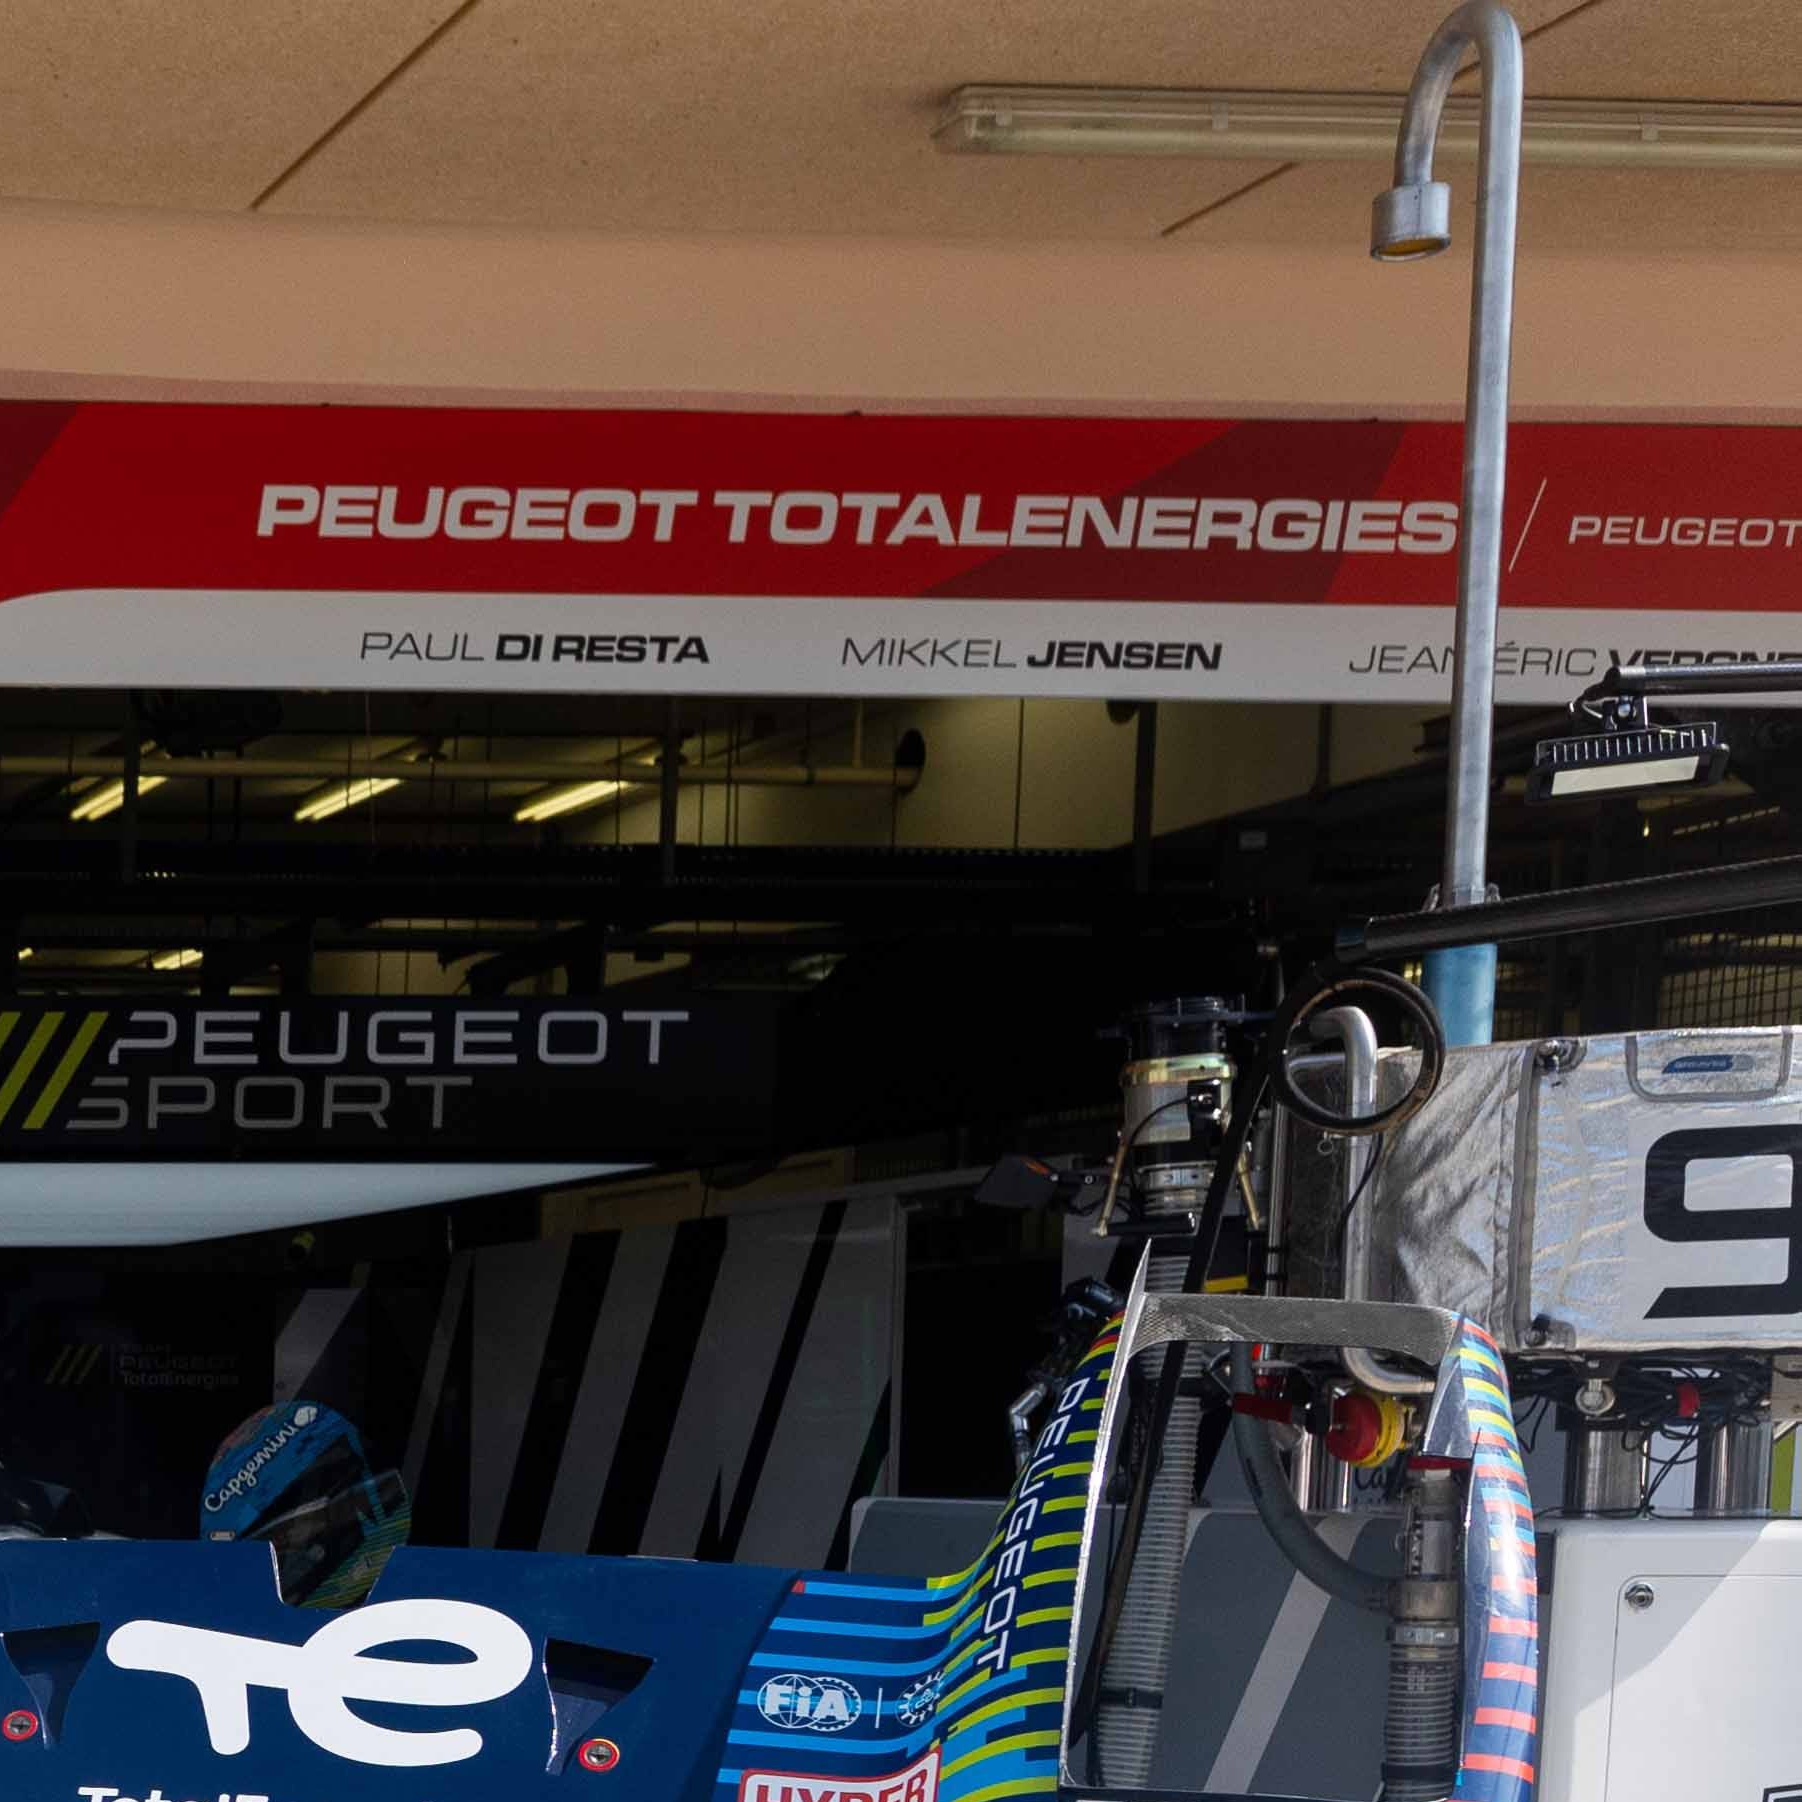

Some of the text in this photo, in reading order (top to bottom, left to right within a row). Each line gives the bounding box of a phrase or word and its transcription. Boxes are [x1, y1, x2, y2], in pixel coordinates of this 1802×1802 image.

[257, 484, 1459, 555] PEUGEOT TOTALENERGIES
[1568, 515, 1802, 549] PEUGEOT
[359, 631, 710, 665] PAUL DI RESTA
[840, 637, 1222, 672] MIKKEL JENSEN
[107, 1010, 690, 1066] PEUGEOT
[65, 1075, 473, 1131] SPORT
[203, 1422, 299, 1513] Capgemini
[977, 1376, 1091, 1671] PEUGEOT
